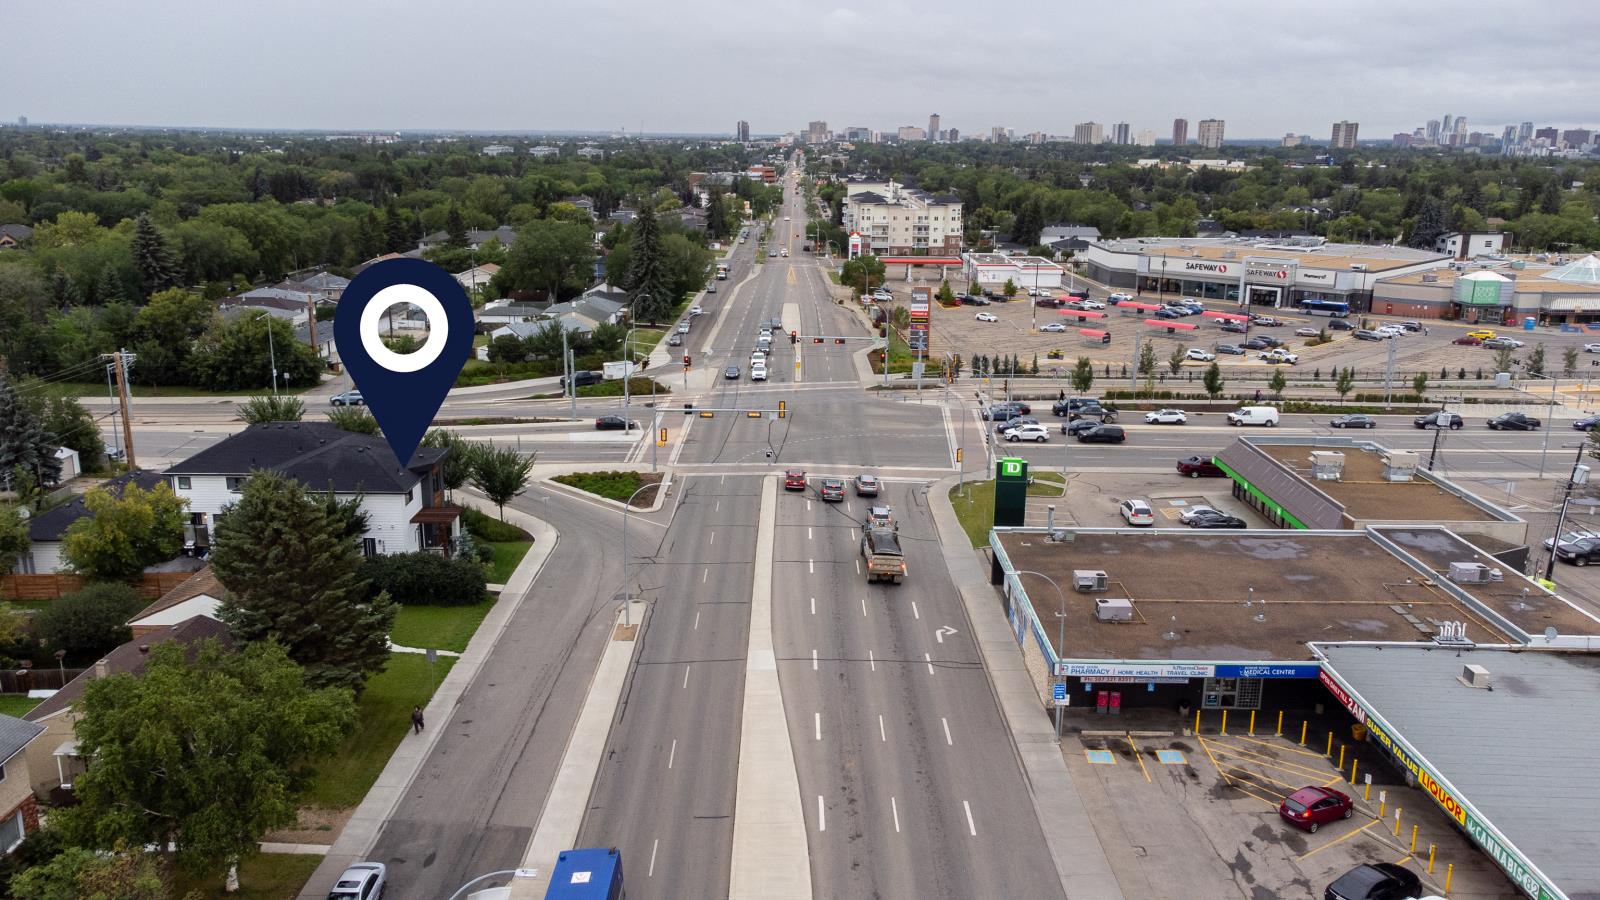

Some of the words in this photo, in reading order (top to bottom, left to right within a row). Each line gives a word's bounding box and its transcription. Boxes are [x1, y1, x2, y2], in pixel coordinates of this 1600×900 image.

[1185, 262, 1218, 272] SAFEWAY
[1246, 268, 1277, 278] SAFEWAY
[1004, 462, 1020, 473] TD
[1347, 697, 1366, 724] 2AM
[1366, 717, 1392, 749] SUPER
[1392, 743, 1418, 776] VALUE
[1421, 772, 1462, 821] LIQUOR
[1475, 827, 1524, 882] CANNABIS
